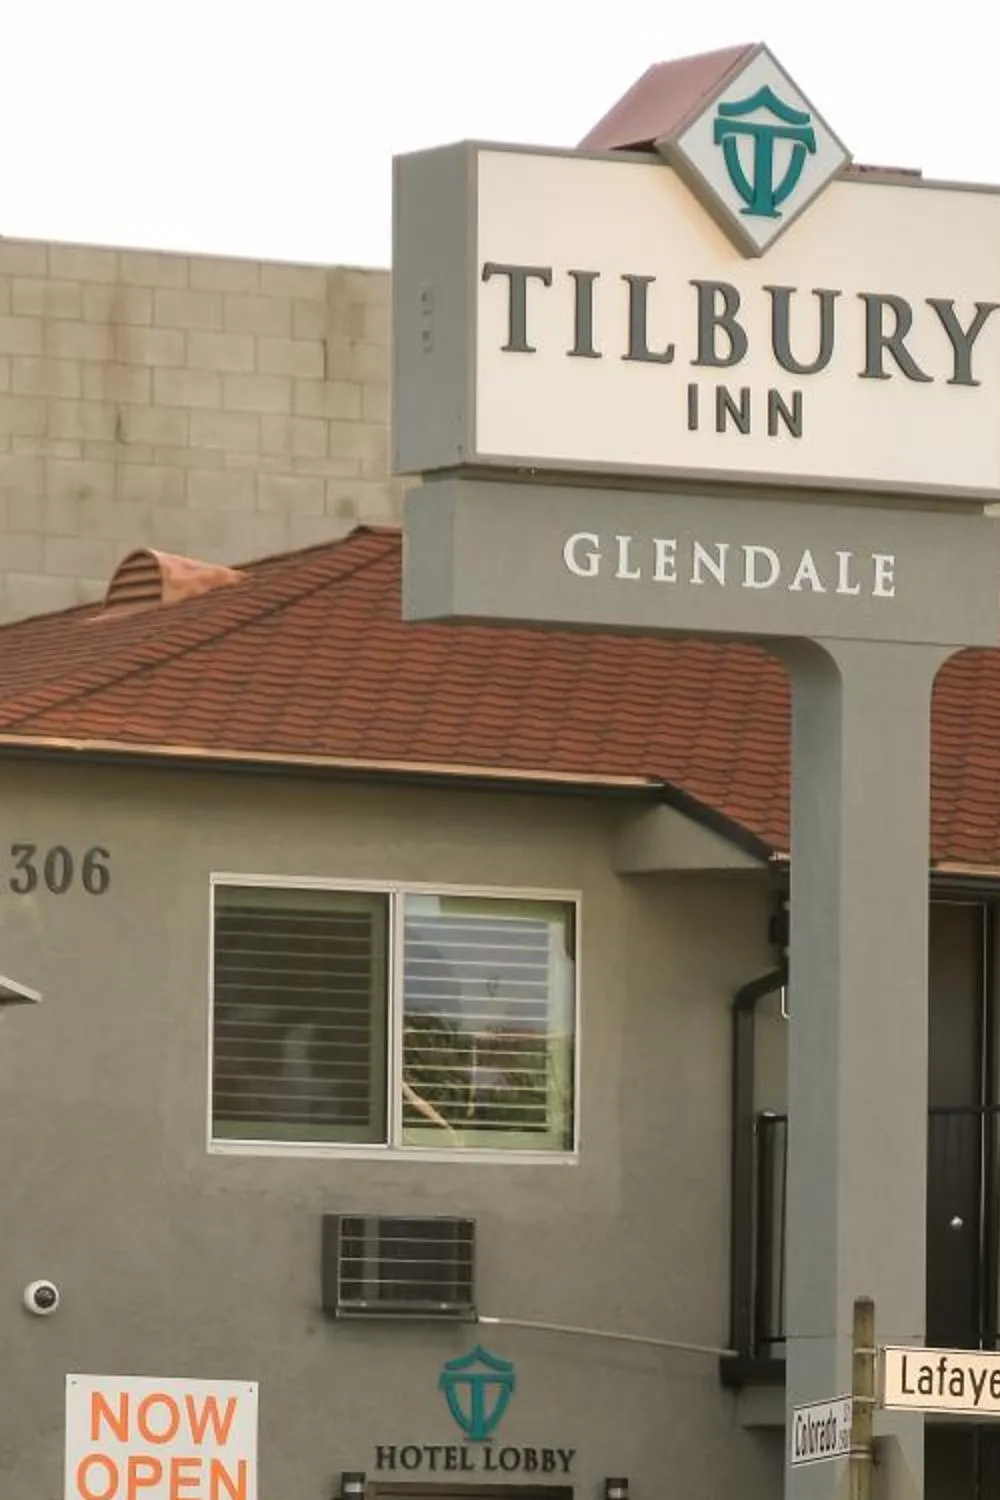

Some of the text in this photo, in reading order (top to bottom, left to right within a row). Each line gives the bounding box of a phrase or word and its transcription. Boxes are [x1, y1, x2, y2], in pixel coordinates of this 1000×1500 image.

[482, 262, 1000, 387] TILBURY
[687, 383, 803, 438] INN
[563, 532, 897, 597] GLENDALE
[10, 845, 111, 895] 306
[90, 1391, 238, 1445] NOW
[374, 1445, 578, 1473] HOTEL LOBBY
